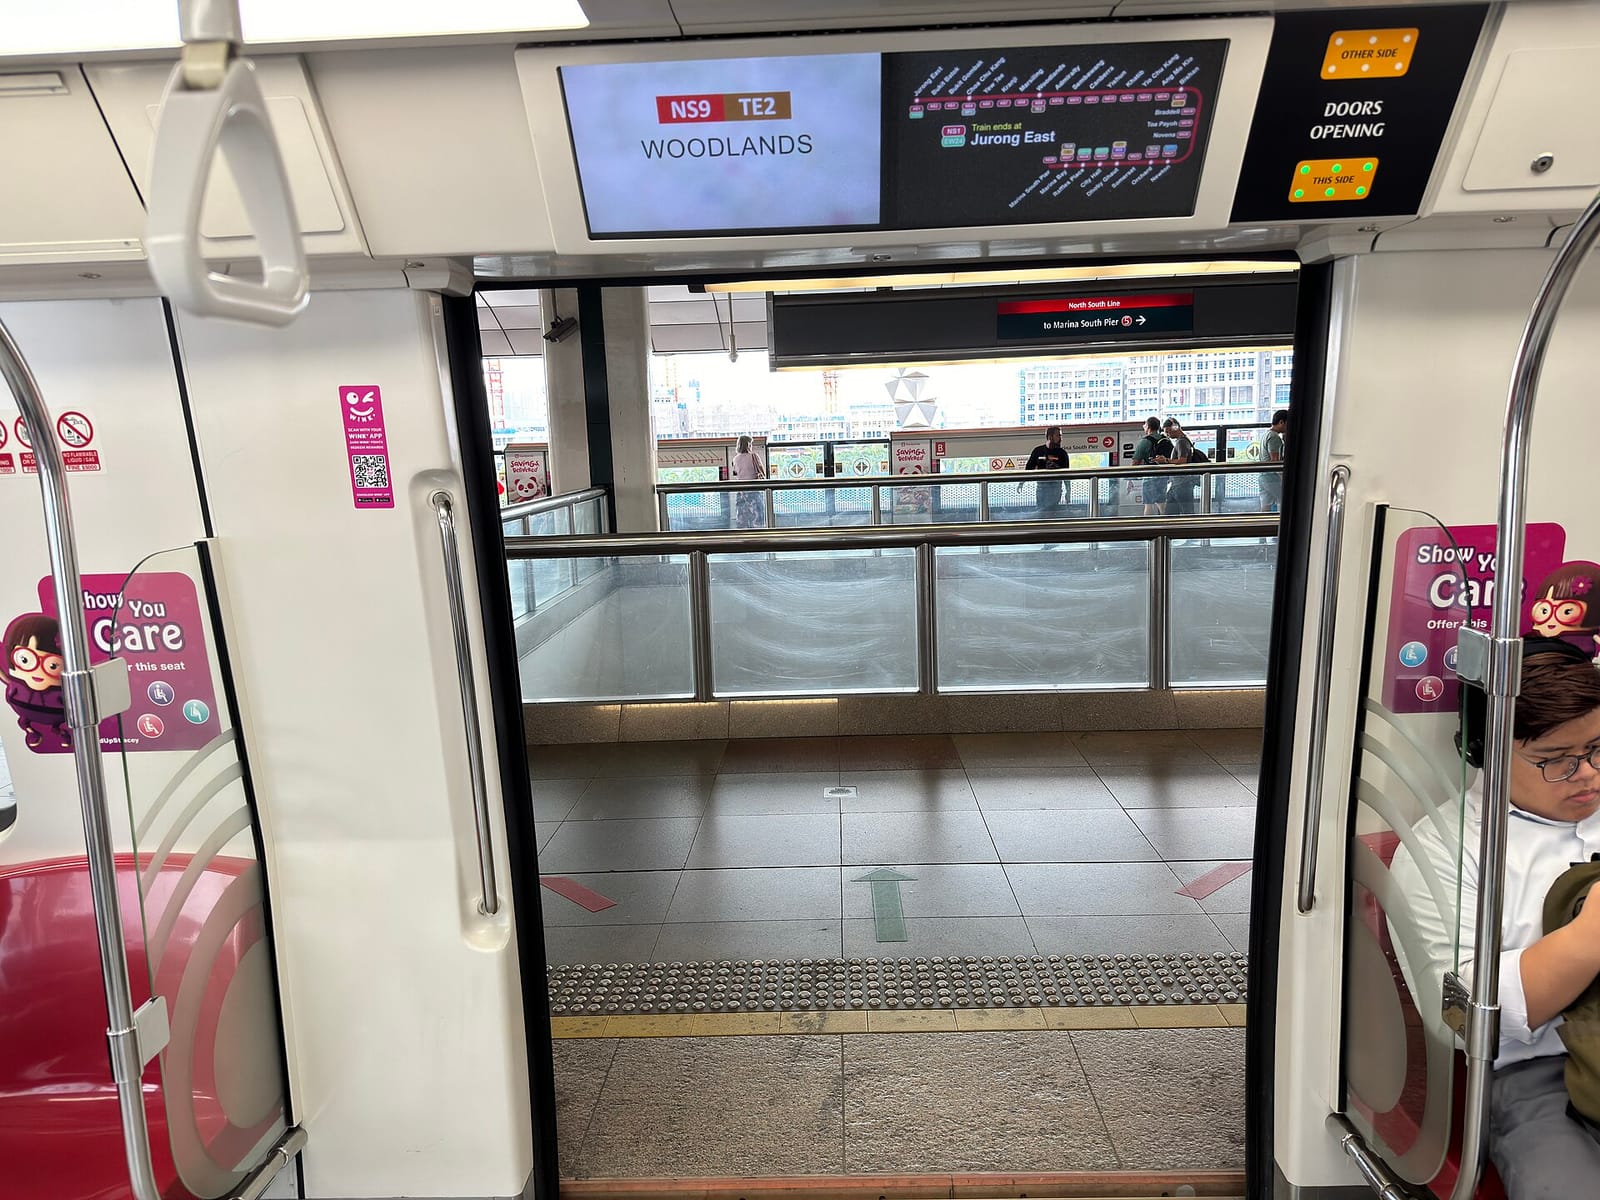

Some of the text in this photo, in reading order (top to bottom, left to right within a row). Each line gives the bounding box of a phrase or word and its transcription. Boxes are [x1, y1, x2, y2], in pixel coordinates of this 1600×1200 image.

[1341, 48, 1398, 60] OTHER SIDE
[671, 97, 776, 120] NS9 TE2
[1324, 101, 1384, 117] DOORS
[972, 122, 1022, 131] Train ends at
[1309, 123, 1385, 140] OPENING
[970, 130, 1056, 146] Jurong East
[641, 134, 813, 160] WOODLANDS
[1312, 175, 1355, 185] THIS SIDE
[1107, 300, 1121, 308] Line
[1043, 322, 1052, 330] to
[1053, 320, 1079, 329] Marina
[1080, 319, 1102, 328] South
[1104, 318, 1119, 327] Pier
[1417, 545, 1475, 564] Show
[83, 591, 166, 618] how You
[1427, 619, 1459, 630] Offer
[93, 619, 183, 652] Care
[135, 661, 158, 671] this
[160, 661, 186, 671] seat
